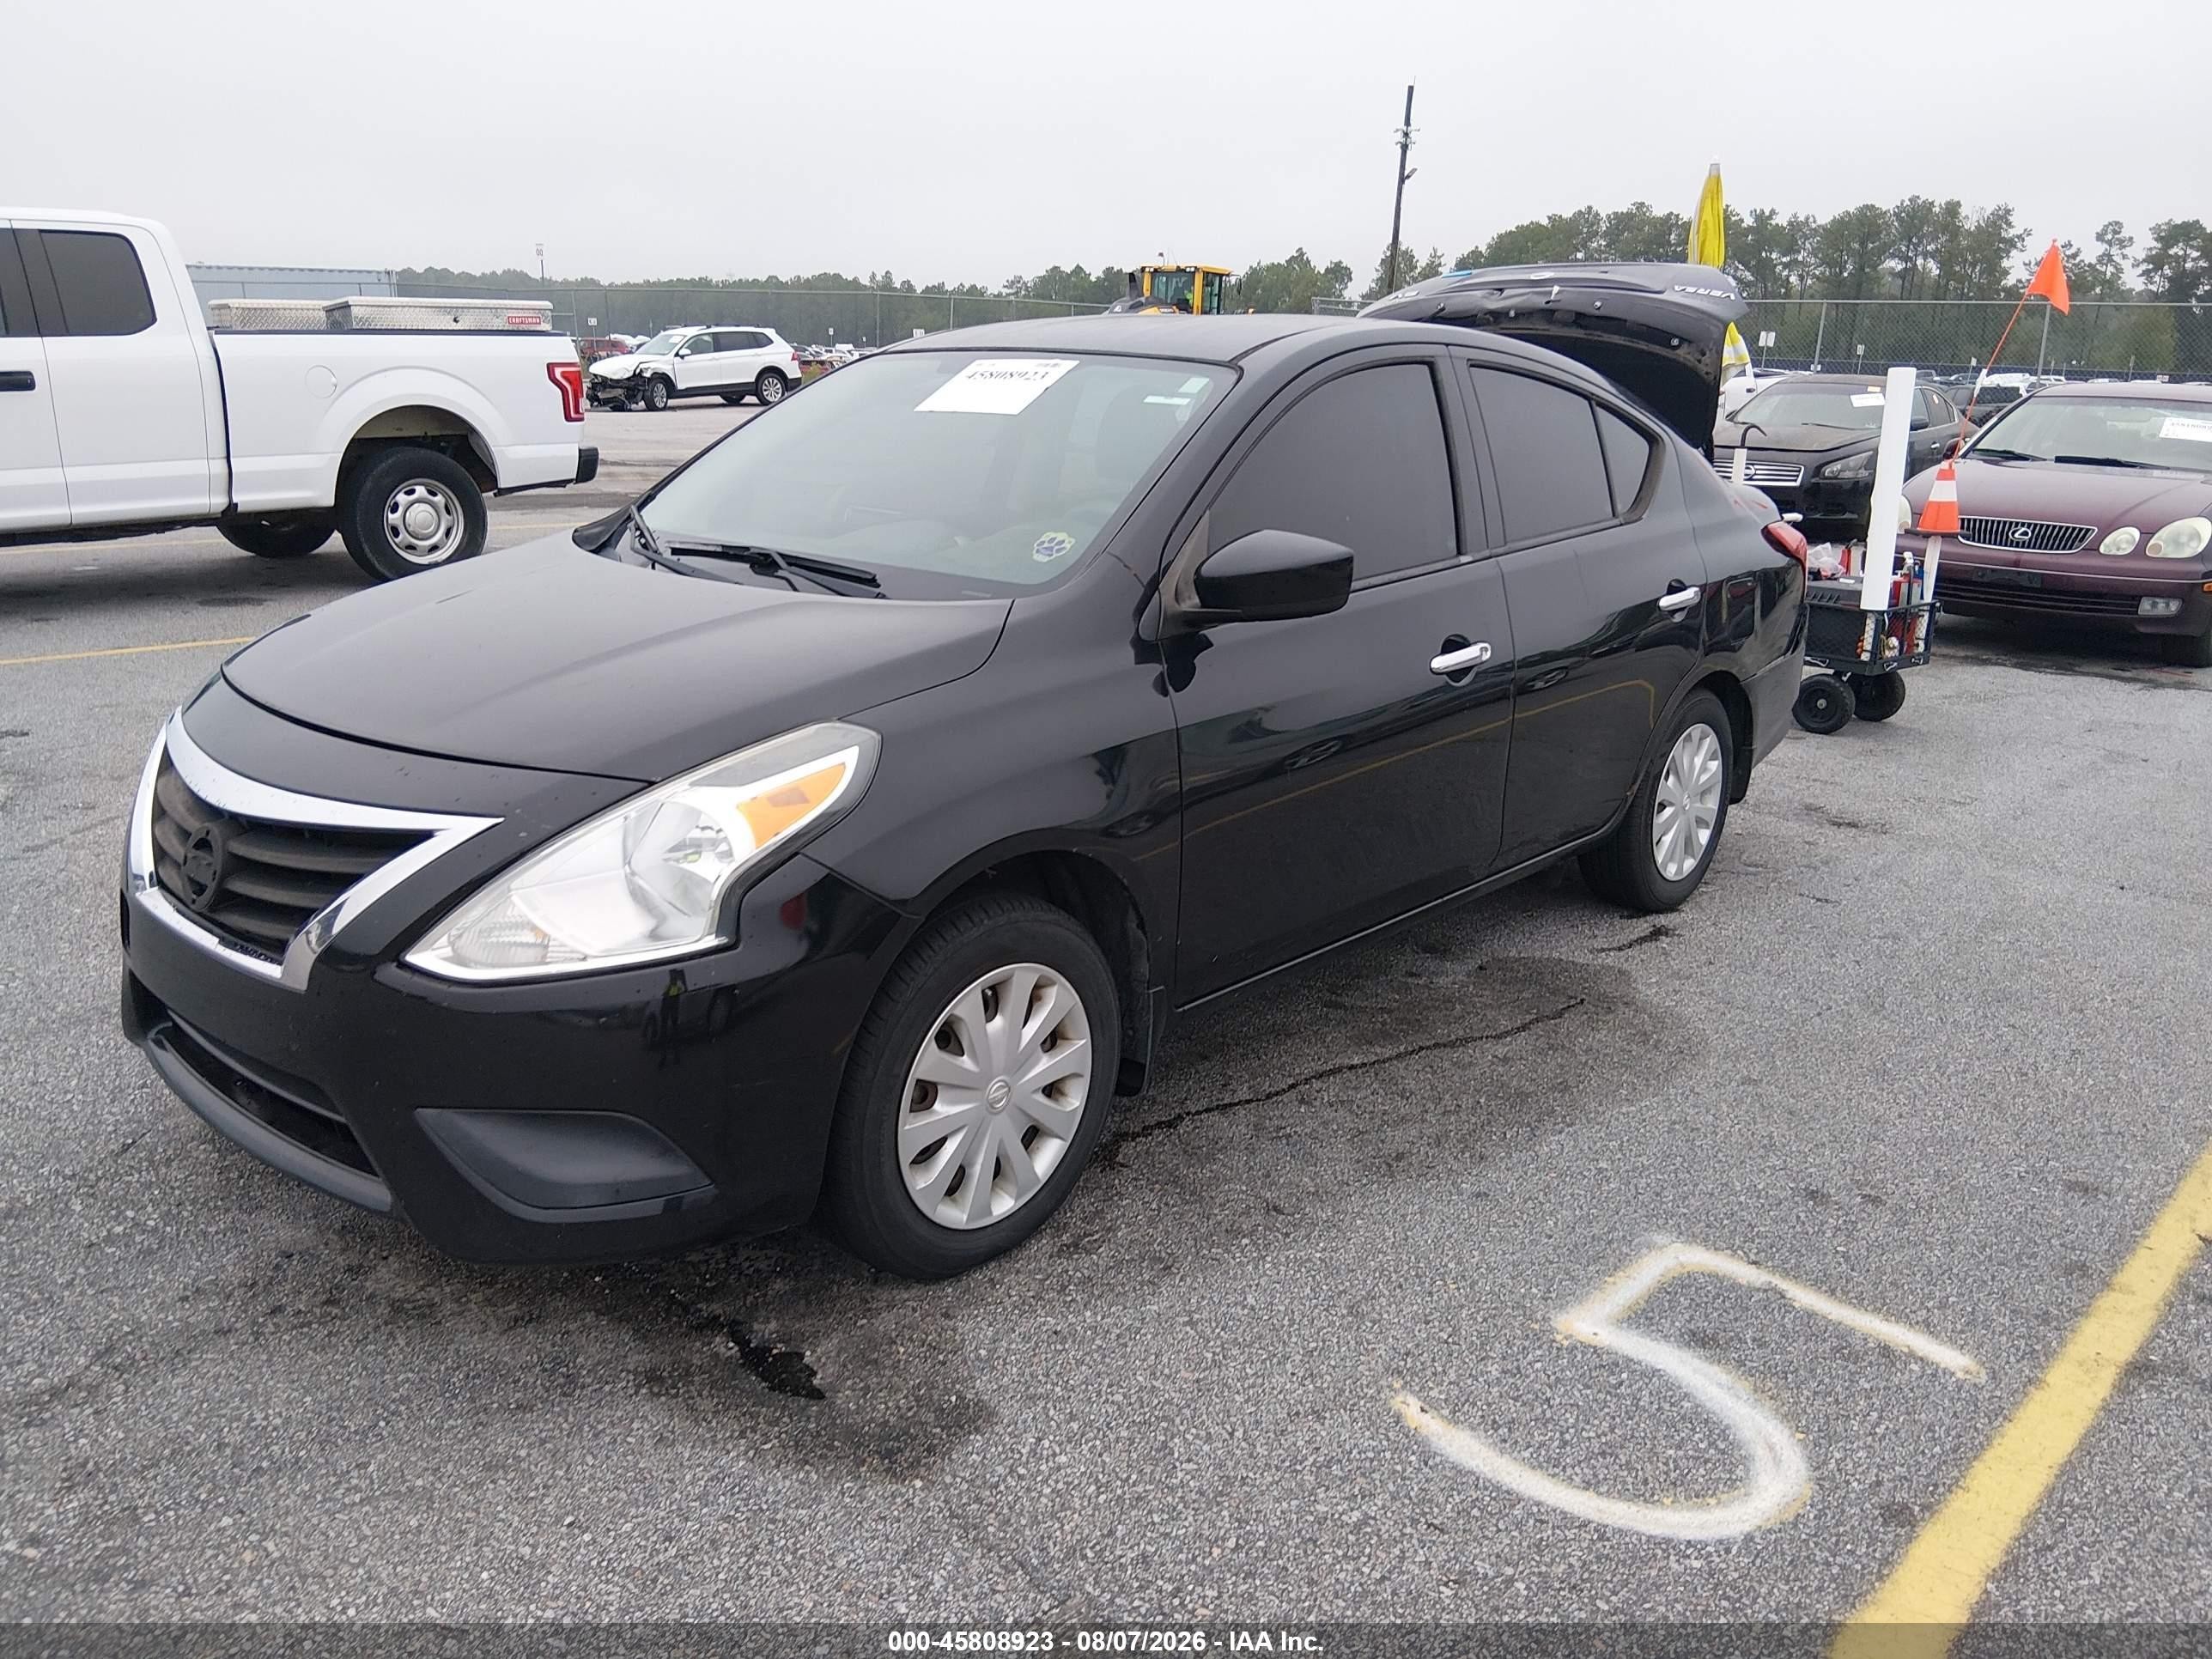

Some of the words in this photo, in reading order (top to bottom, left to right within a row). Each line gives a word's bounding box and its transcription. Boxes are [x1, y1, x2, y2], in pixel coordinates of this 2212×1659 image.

[1674, 284, 1735, 301] VERSA
[508, 316, 541, 325] CRAFTSMAN
[965, 370, 1049, 381] 45808923
[1391, 1242, 1986, 1543] 5
